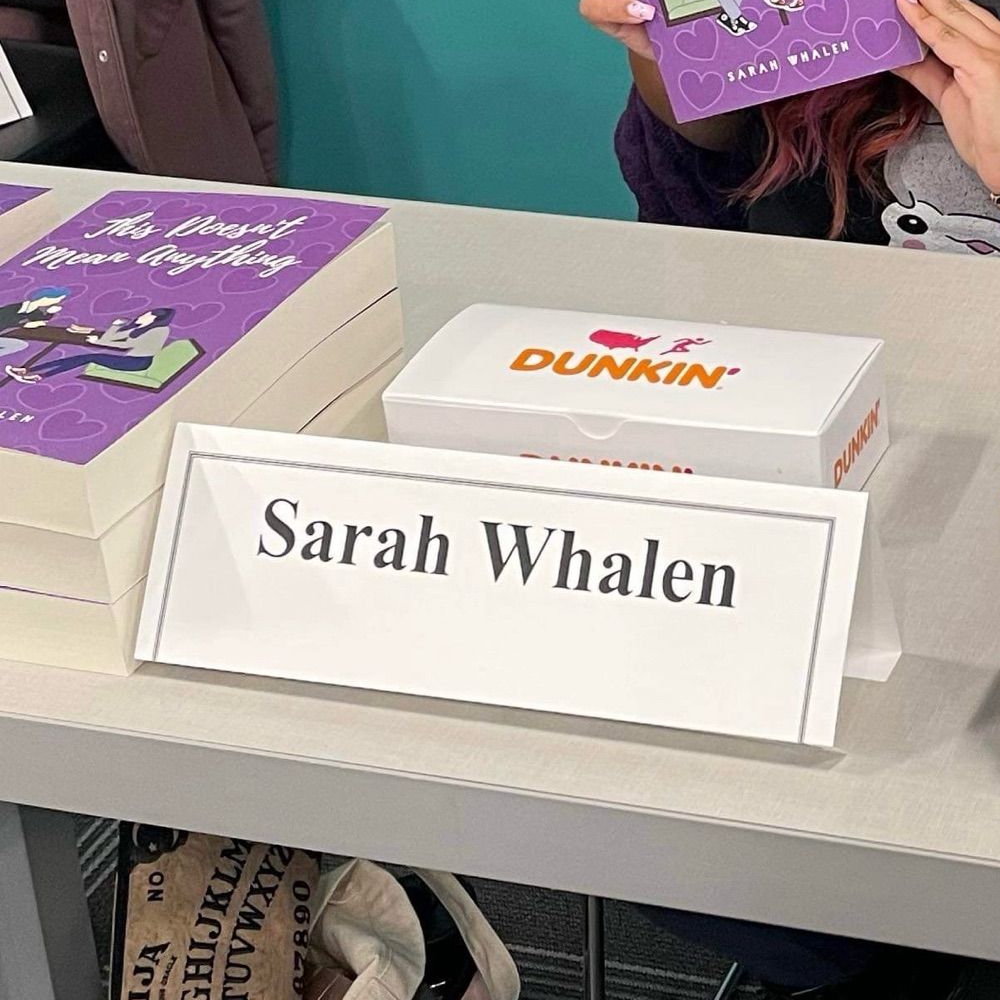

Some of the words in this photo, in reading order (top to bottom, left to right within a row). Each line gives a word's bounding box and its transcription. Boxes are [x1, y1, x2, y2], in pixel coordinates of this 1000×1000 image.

[727, 59, 779, 83] SARAH
[787, 40, 851, 67] WHALEN
[84, 211, 162, 239] This
[165, 214, 307, 241] Doesn't
[22, 245, 131, 270] Mean
[137, 239, 302, 278] Anything
[509, 348, 741, 389] DUNKIN'
[256, 498, 451, 577] Sarah
[479, 519, 738, 609] Whalen
[147, 871, 165, 902] NO
